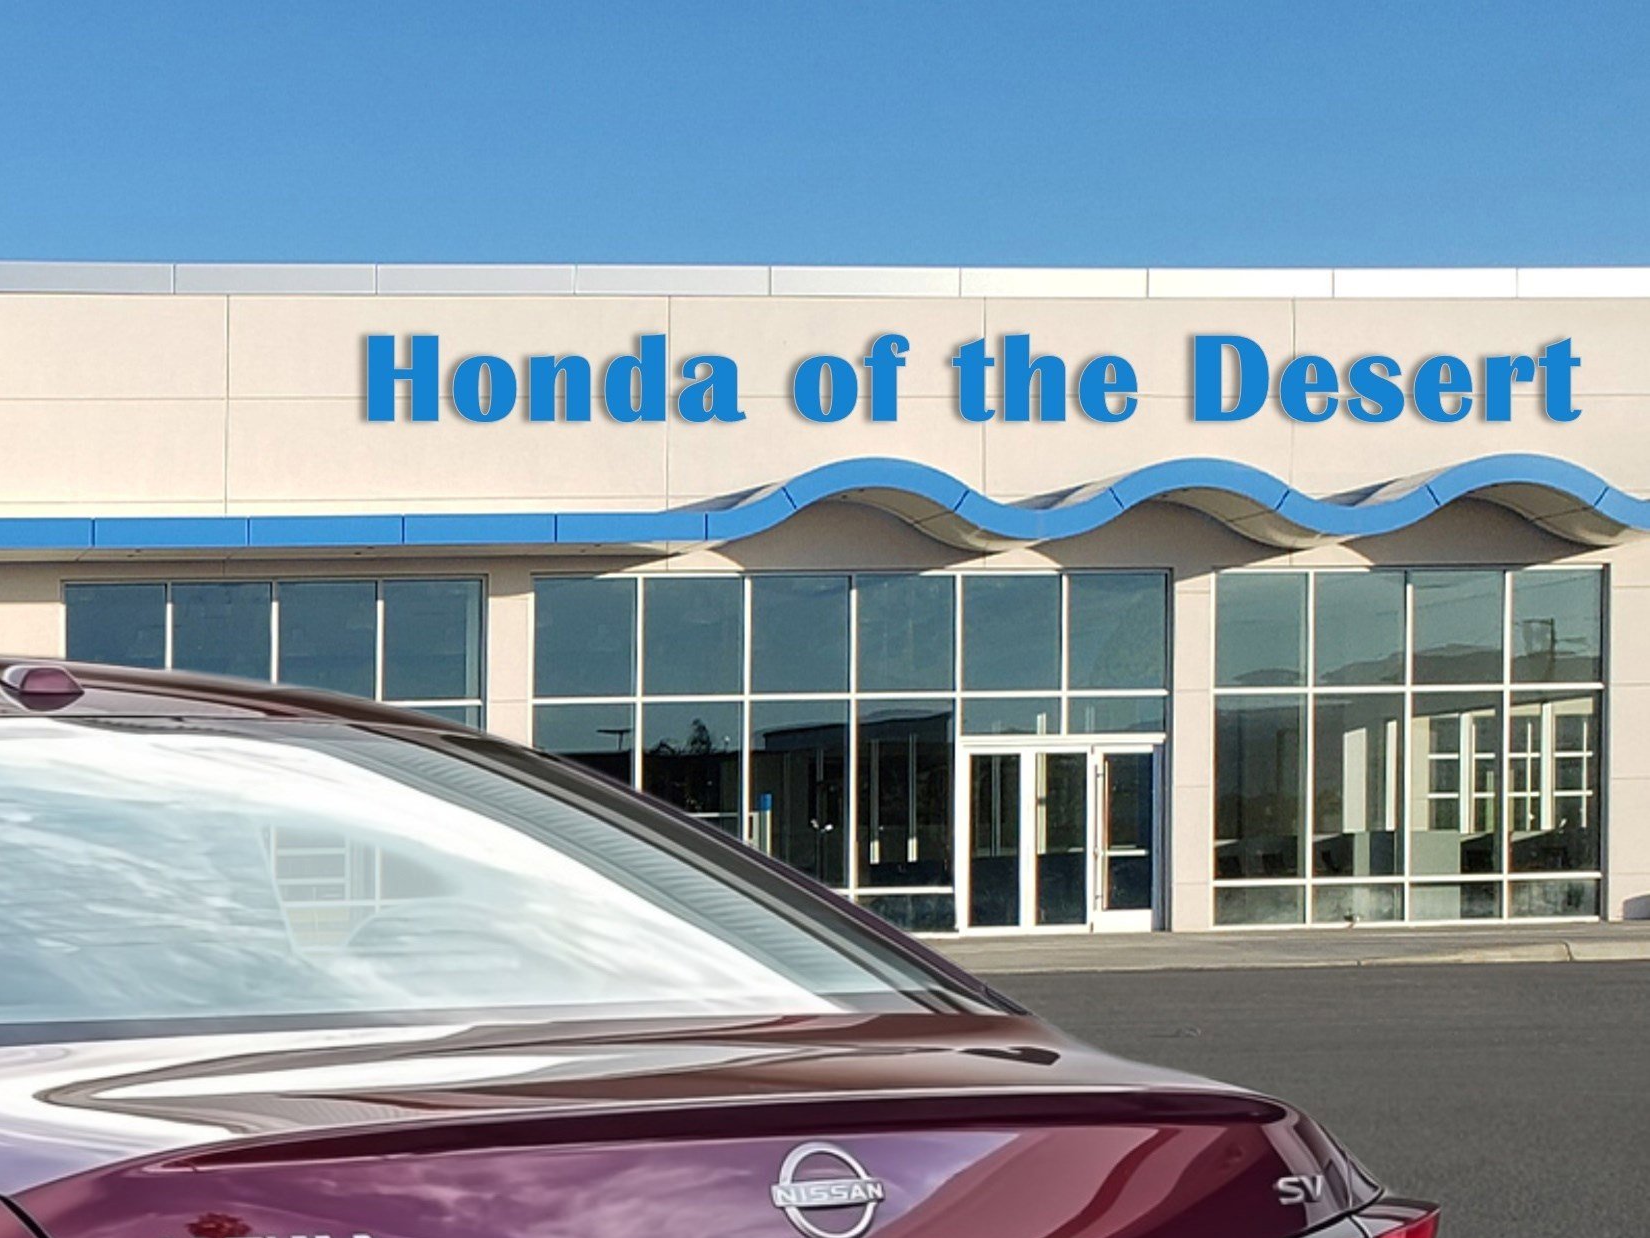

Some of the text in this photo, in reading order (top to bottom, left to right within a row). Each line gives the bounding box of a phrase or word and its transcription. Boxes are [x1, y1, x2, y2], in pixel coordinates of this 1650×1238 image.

[365, 332, 1583, 424] Honda of the Desert
[775, 1181, 885, 1205] NISSAN
[1275, 1174, 1324, 1205] SV
